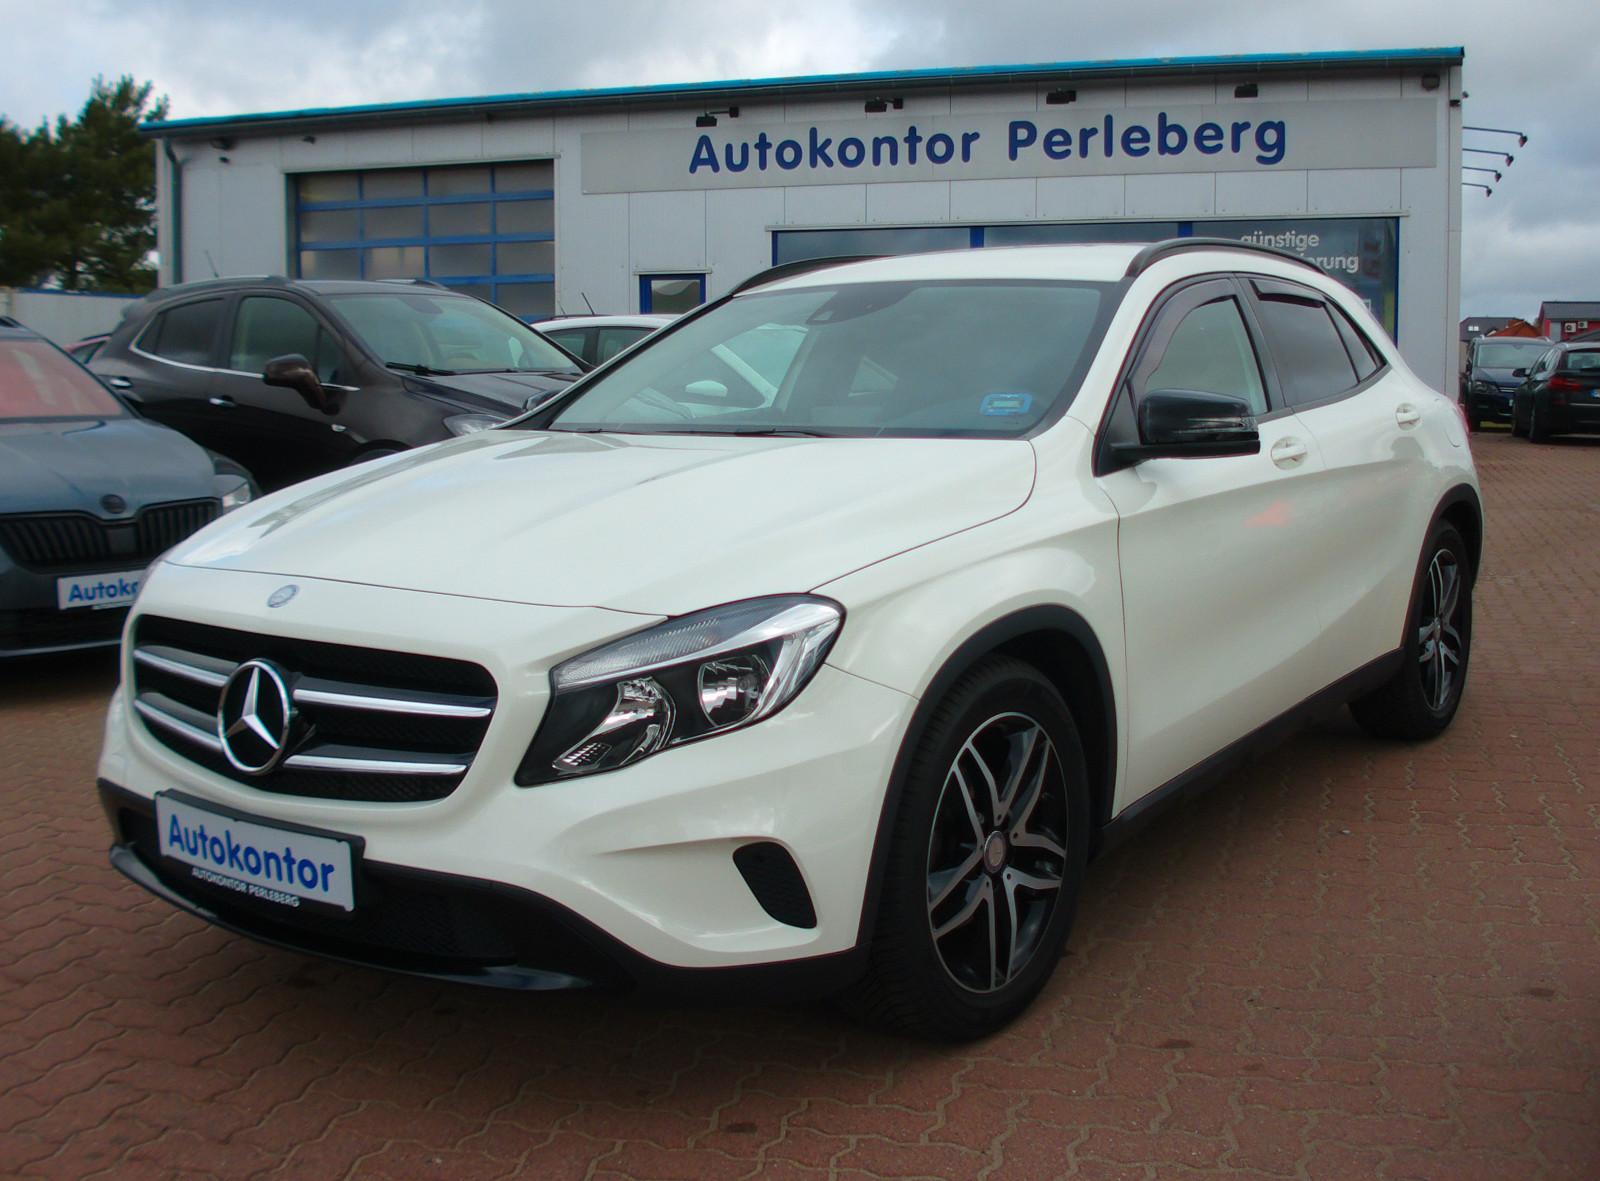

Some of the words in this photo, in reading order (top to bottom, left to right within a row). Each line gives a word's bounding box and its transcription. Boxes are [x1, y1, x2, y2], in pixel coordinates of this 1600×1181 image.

[688, 125, 981, 175] Autokontor
[1007, 112, 1287, 166] Perleberg
[168, 814, 336, 893] Autokontor
[191, 867, 247, 894] AUTOKONTOR
[247, 884, 300, 908] PERLEBERG
